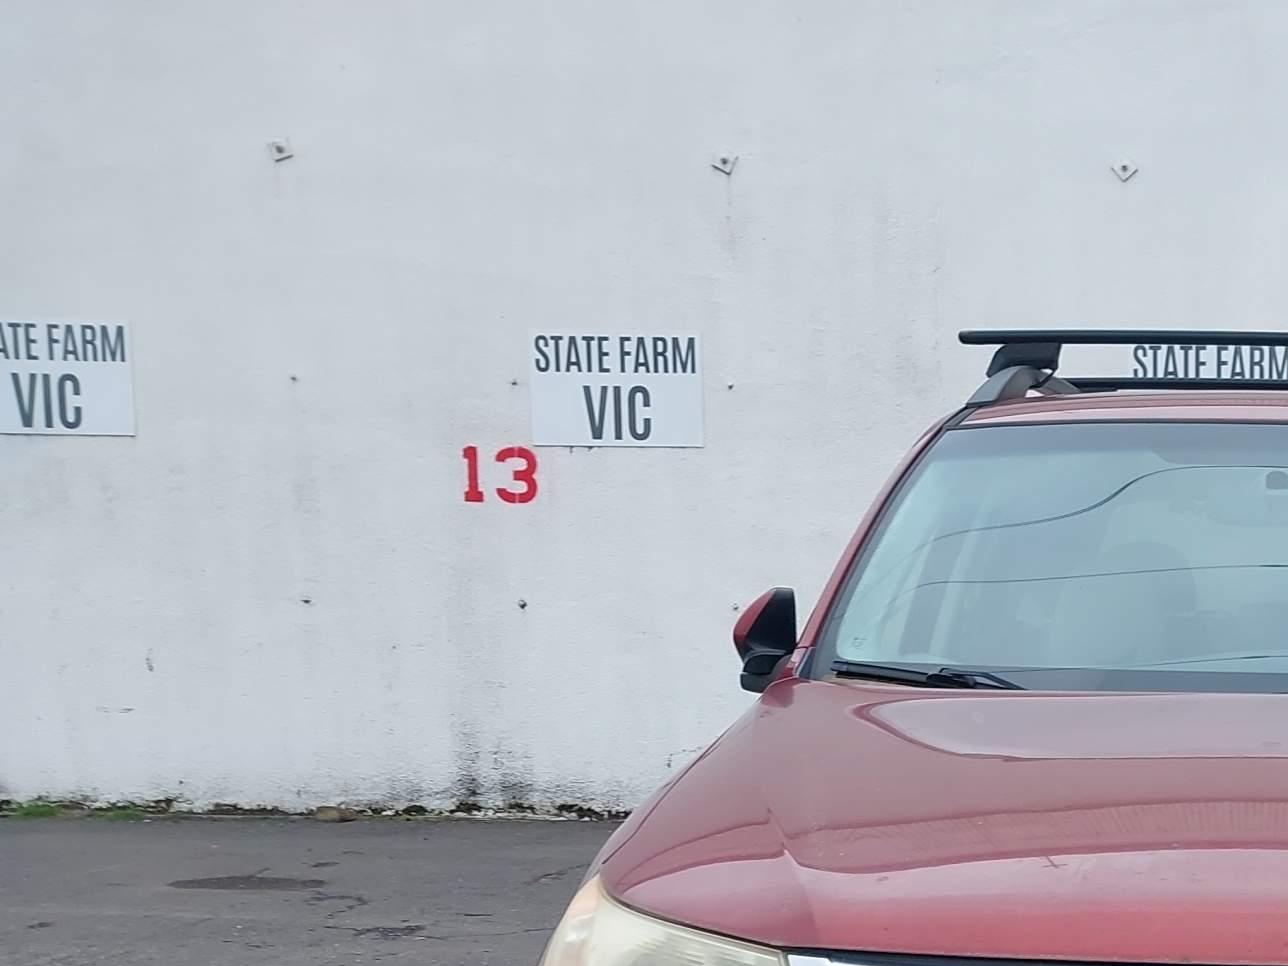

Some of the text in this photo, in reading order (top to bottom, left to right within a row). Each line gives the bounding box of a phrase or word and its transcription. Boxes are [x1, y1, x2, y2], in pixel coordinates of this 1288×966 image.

[46, 323, 126, 362] FARM
[534, 335, 697, 374] STATE FARM
[1133, 345, 1207, 378] STATE
[11, 372, 82, 429] VIC
[583, 385, 652, 441] VIC
[463, 445, 538, 504] 13
